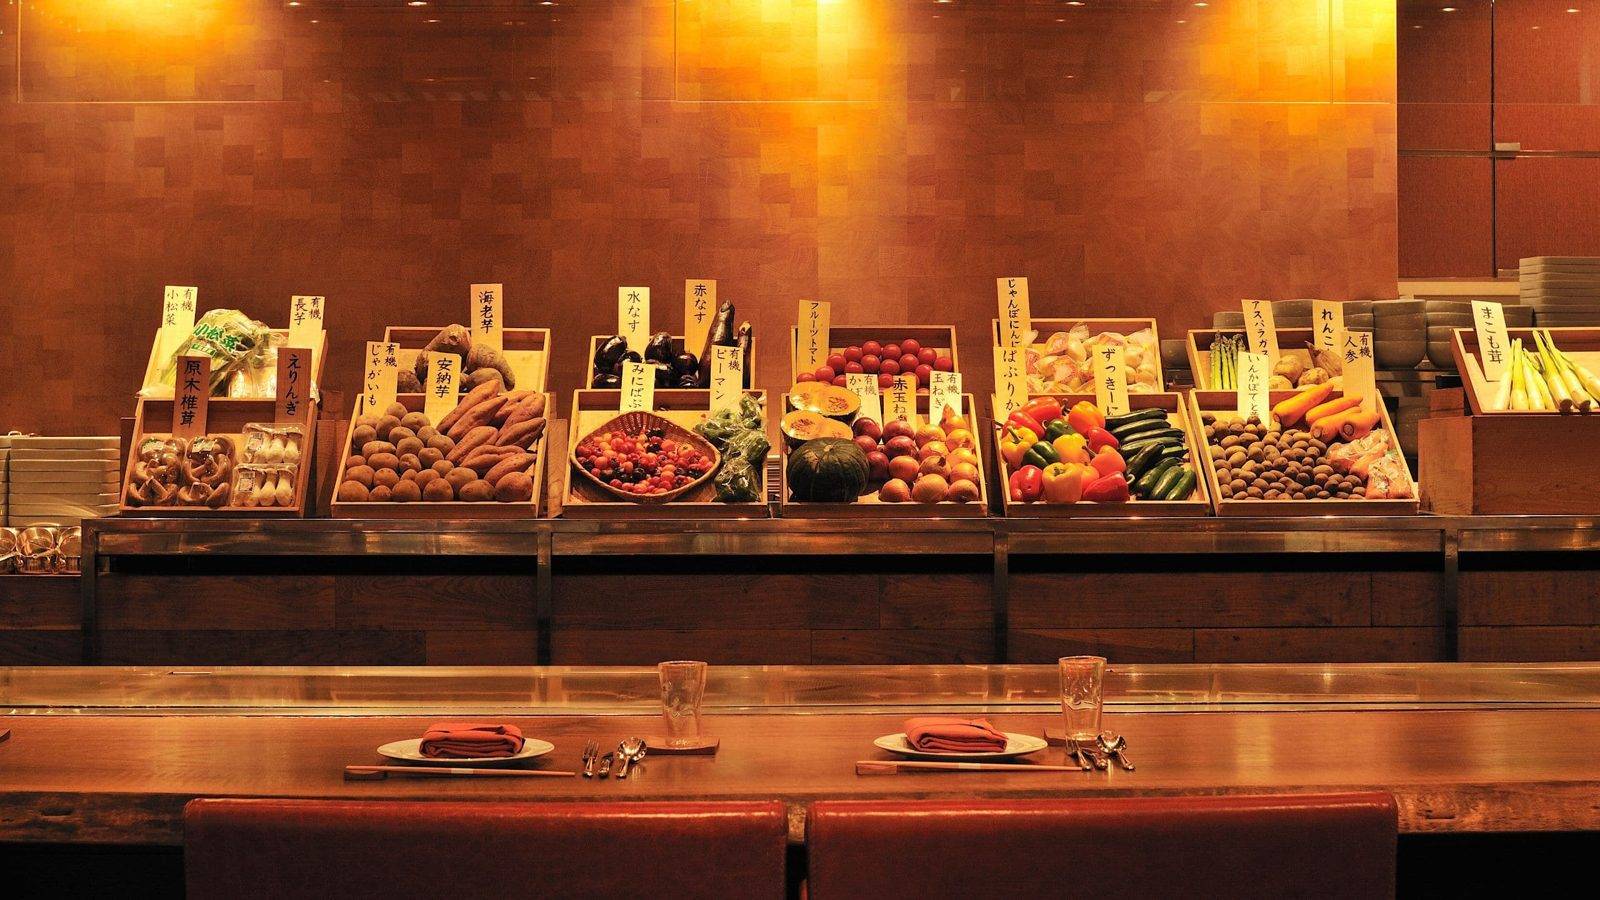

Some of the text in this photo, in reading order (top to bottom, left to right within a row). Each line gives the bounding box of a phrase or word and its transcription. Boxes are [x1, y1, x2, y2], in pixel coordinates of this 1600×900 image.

[165, 289, 178, 326] 小松菜
[181, 289, 194, 312] 有機
[294, 297, 308, 326] 長芋
[310, 296, 322, 320] 有機
[478, 290, 494, 334] 海老芋
[627, 291, 641, 333] 水なす
[693, 283, 707, 324] 赤なす
[192, 323, 240, 352] 小松菜
[809, 302, 819, 365] フルーツトマト
[1252, 300, 1270, 357] アスパラガス
[1322, 308, 1334, 351] れんこ
[1359, 333, 1372, 358] 有機
[1481, 306, 1502, 364] まこも茸
[384, 343, 397, 367] 有機
[728, 348, 741, 372] 有機
[1344, 336, 1358, 363] 人参
[180, 360, 201, 427] 原木椎茸
[285, 353, 301, 417] えりんぎ
[367, 344, 381, 406] じゃがいも
[435, 357, 453, 398] 安納芋
[715, 348, 726, 400] ピーマン
[864, 374, 877, 395] 有機
[932, 373, 946, 408] 玉ねぎ
[947, 373, 960, 395] 有機
[1002, 350, 1021, 411] ぱぷりか
